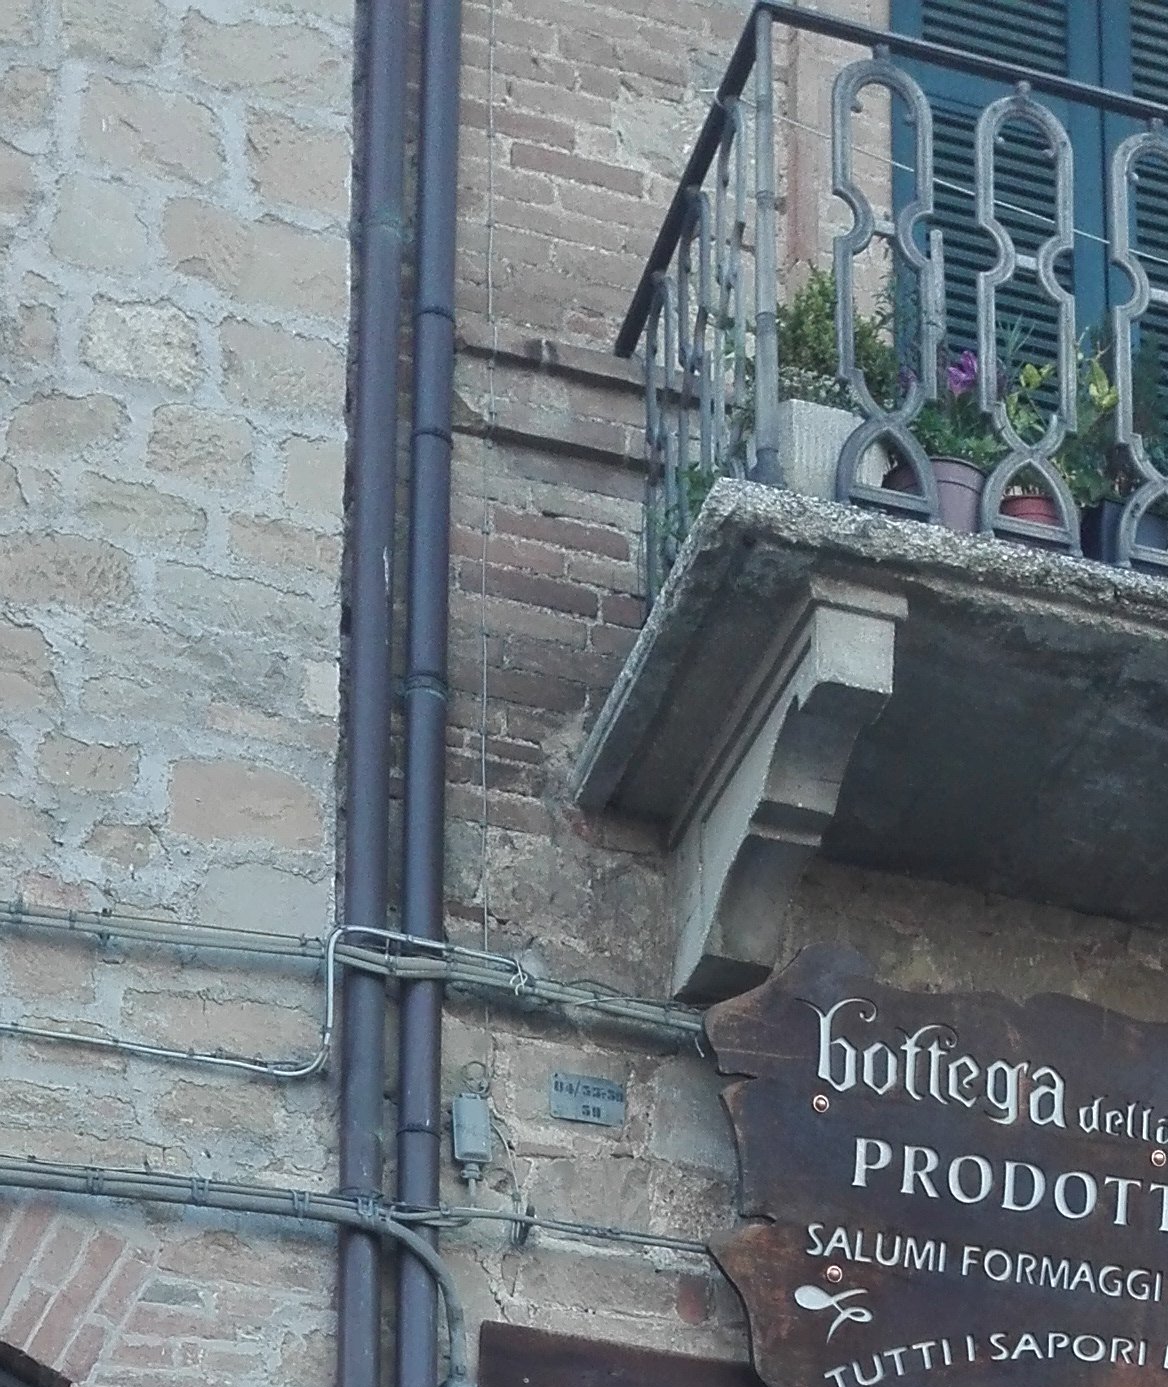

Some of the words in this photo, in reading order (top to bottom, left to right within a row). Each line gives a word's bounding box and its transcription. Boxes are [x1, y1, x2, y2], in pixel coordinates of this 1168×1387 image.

[805, 997, 1066, 1130] bottega
[806, 1222, 947, 1274] SALUMI
[961, 1245, 1163, 1302] FORMAGGI
[967, 1334, 976, 1362] I
[989, 1330, 1146, 1366] SAPORI
